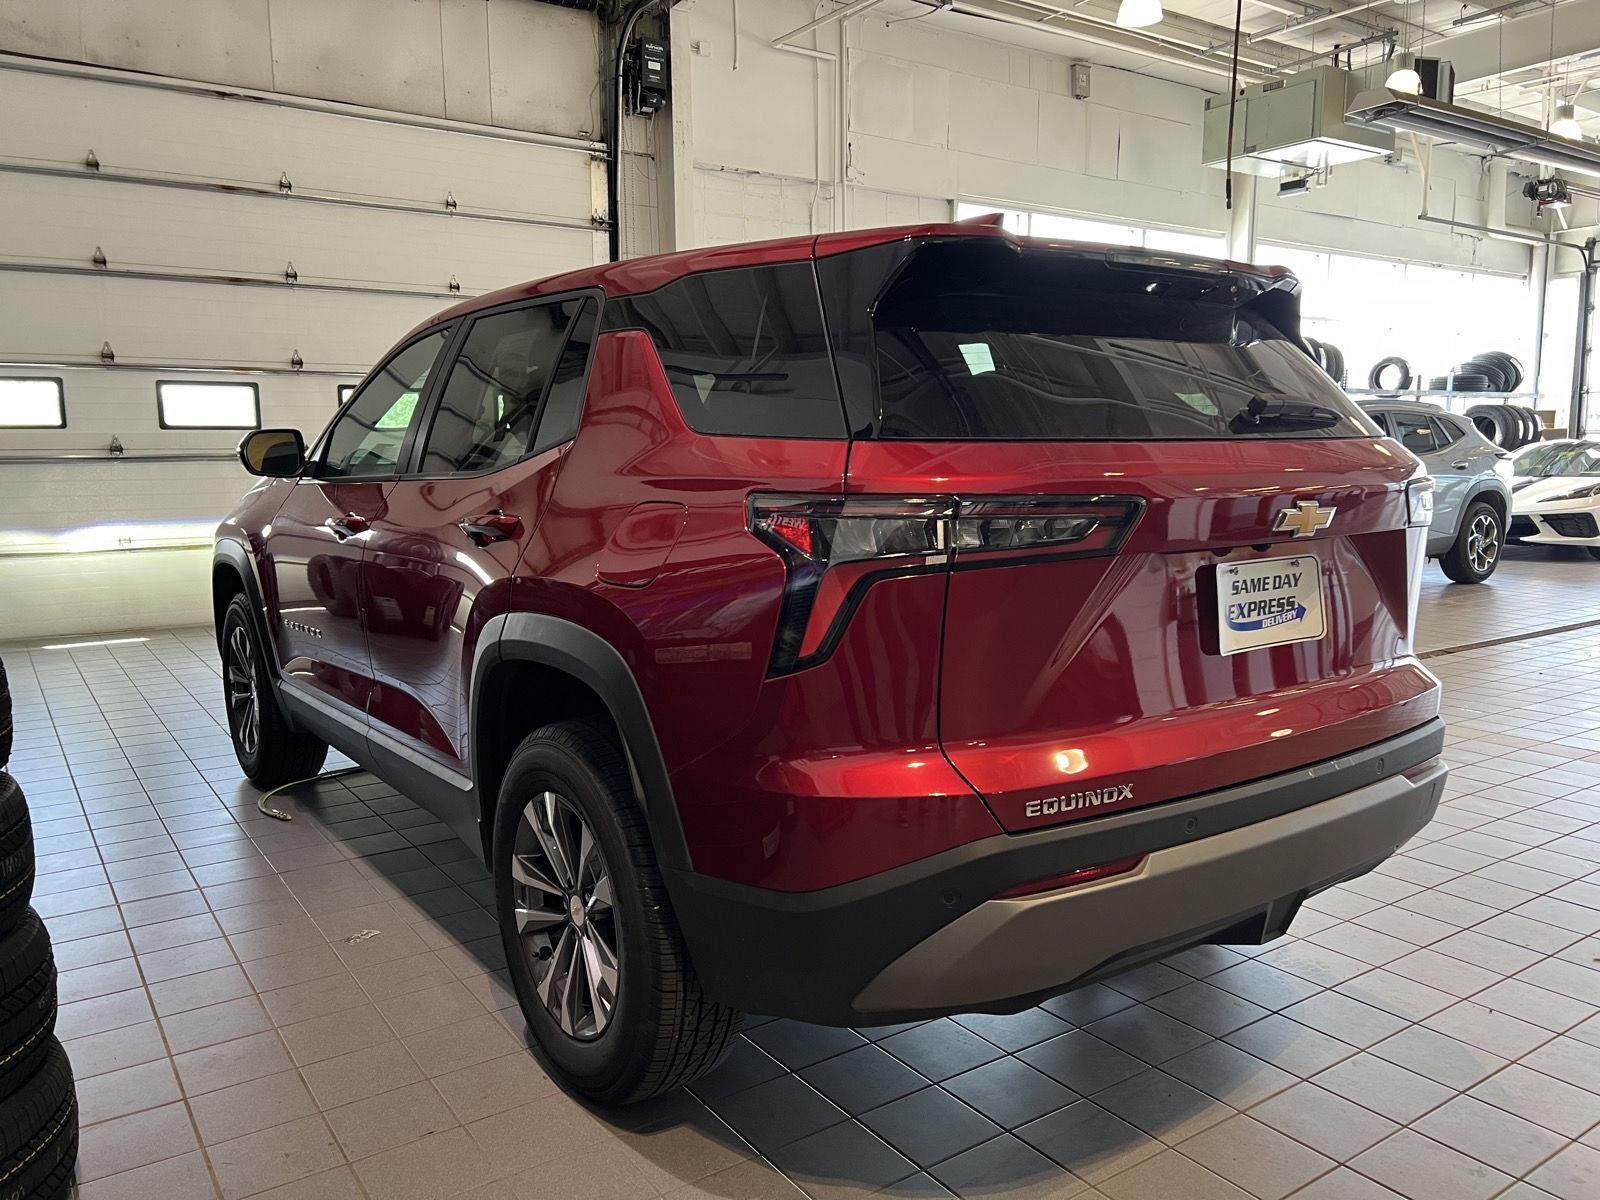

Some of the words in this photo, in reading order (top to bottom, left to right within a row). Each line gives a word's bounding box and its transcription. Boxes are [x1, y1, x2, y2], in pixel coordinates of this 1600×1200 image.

[1231, 576, 1270, 596] SAME
[1272, 572, 1302, 588] DAY
[1228, 595, 1296, 621] EXPRESS
[1262, 609, 1298, 628] DELIVERY
[1025, 783, 1134, 817] EQUINOX
